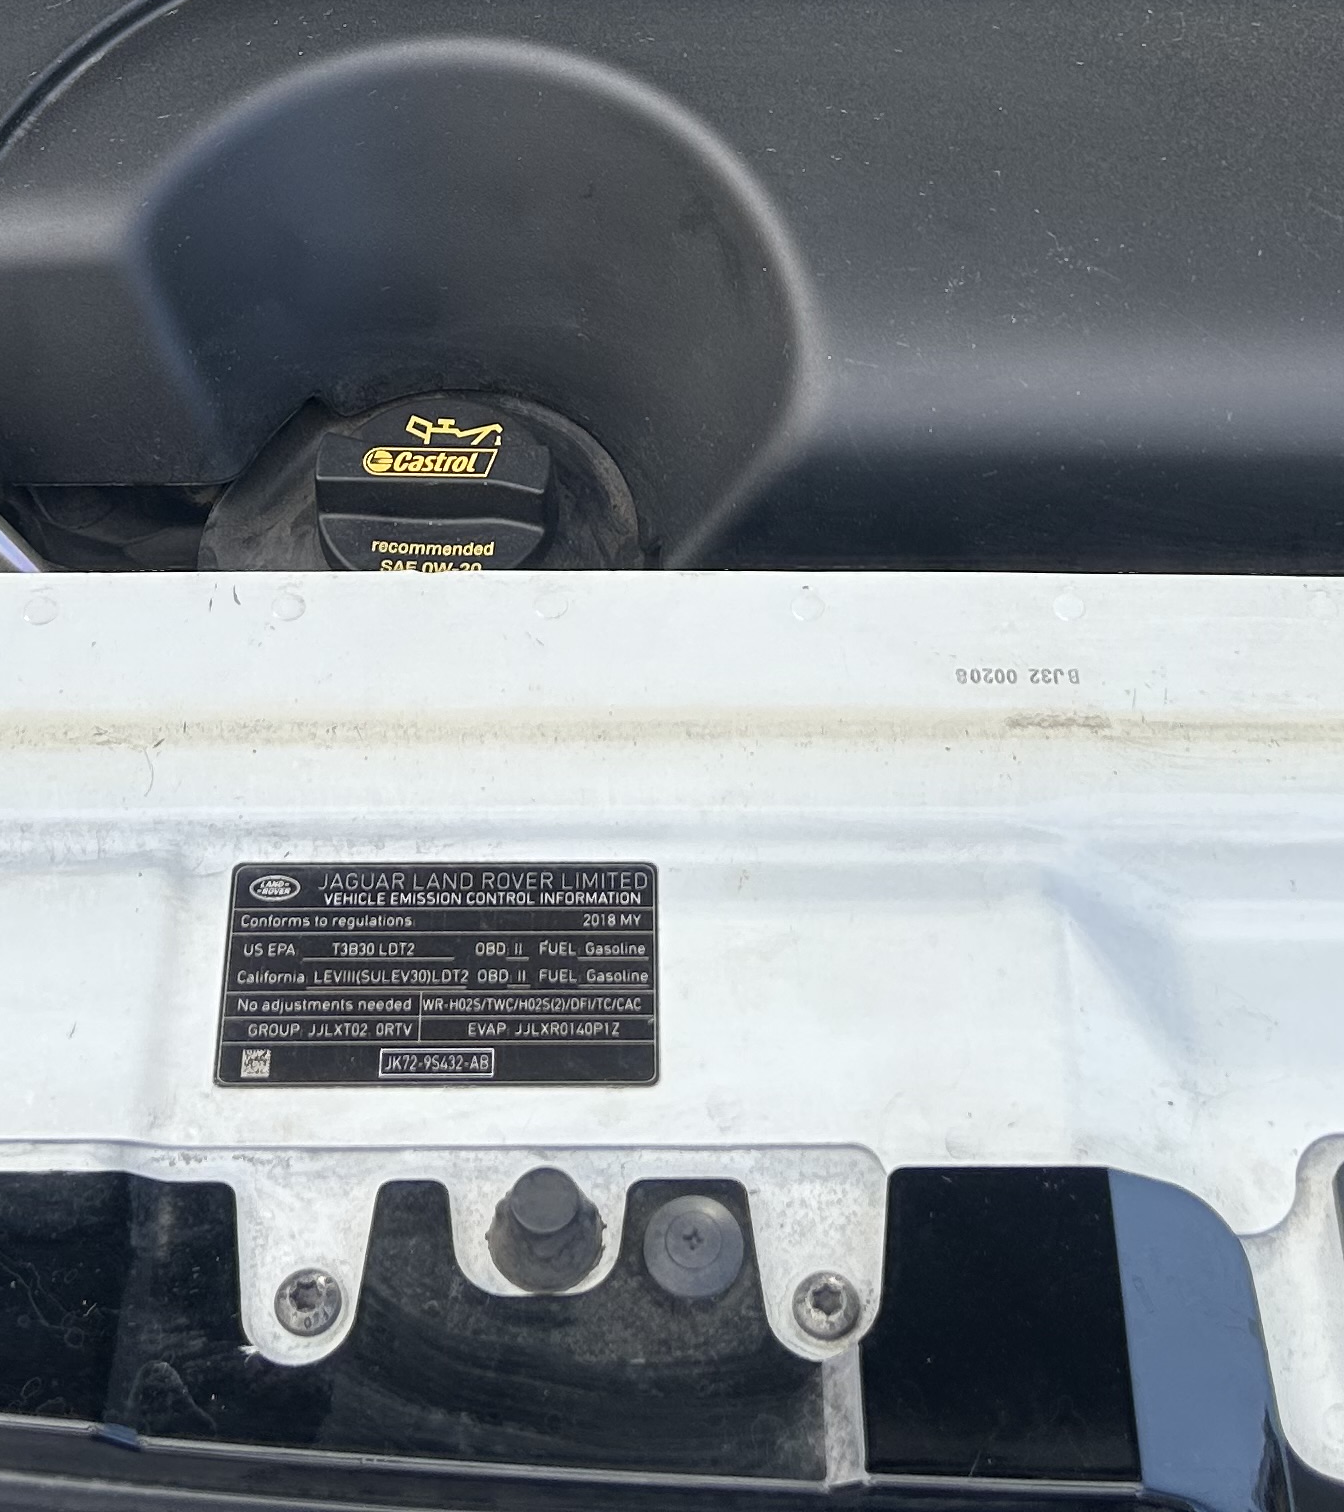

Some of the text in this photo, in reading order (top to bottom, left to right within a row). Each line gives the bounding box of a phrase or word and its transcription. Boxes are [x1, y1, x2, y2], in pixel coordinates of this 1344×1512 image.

[393, 450, 478, 473] Castrol
[371, 539, 495, 556] recommended
[955, 668, 1018, 685] 00208
[260, 880, 285, 888] LAND
[318, 872, 648, 890] JAGUAR LAND ROVER LIMITED
[261, 888, 292, 896] ROVER
[324, 891, 641, 906] VEHICLE EMISSION CONTROL INFORMATION
[241, 914, 310, 928] Conforms
[315, 915, 328, 927] to
[583, 913, 642, 927] 2018 MY
[243, 941, 646, 957] US EPA T3B30 LDT2 OBD II FUEL Gasoline
[237, 969, 305, 984] California
[477, 969, 509, 984] OBD
[517, 970, 526, 982] II
[539, 969, 577, 982] FUEL
[586, 968, 649, 982] Gasoline
[237, 997, 412, 1014] No adjustments needed
[248, 1023, 300, 1037] GROUP
[468, 1022, 506, 1037] EVAP
[384, 1054, 489, 1072] JK72-9S432-AB
